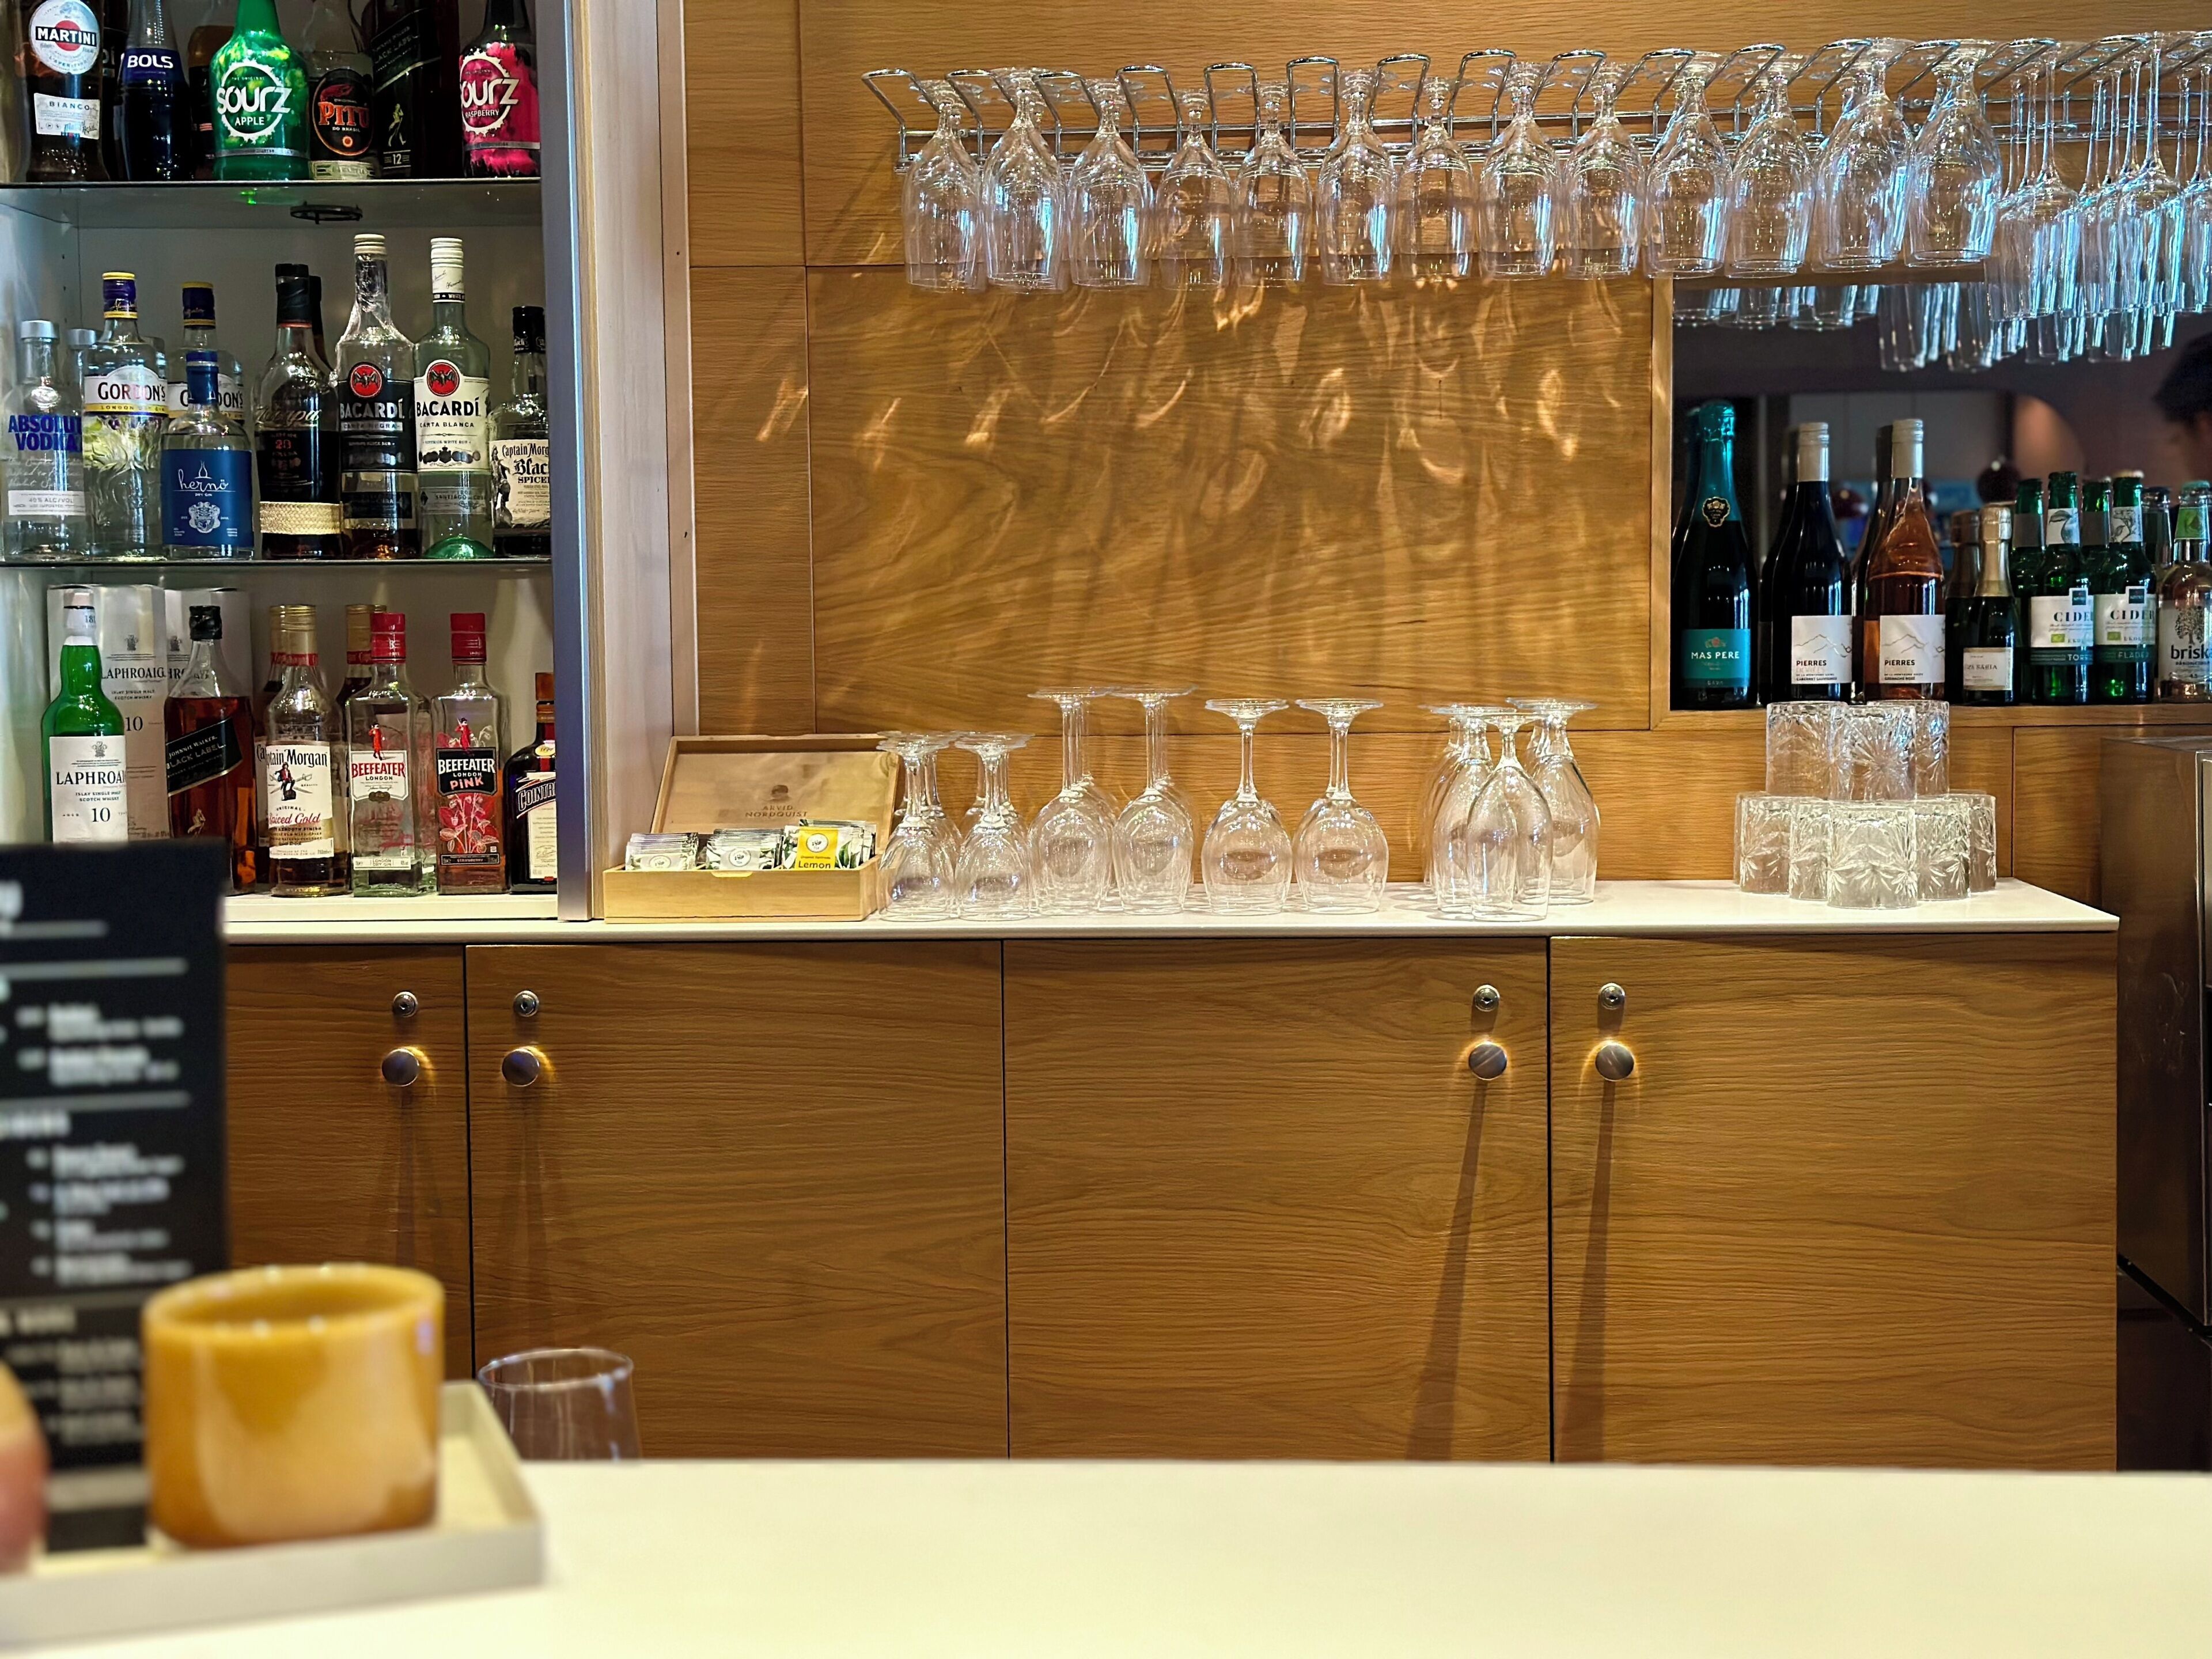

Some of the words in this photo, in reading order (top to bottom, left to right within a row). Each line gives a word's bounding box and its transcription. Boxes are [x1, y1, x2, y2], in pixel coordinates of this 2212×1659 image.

[37, 28, 95, 46] MARTINI
[127, 55, 173, 69] BOLS
[460, 78, 520, 108] ourz
[49, 101, 90, 111] BIANCO
[465, 109, 499, 118] RASPBERRY
[235, 116, 265, 126] APPLE
[393, 153, 402, 165] 12
[97, 381, 166, 402] GORDON'S
[339, 397, 403, 419] BACARDÍ
[416, 396, 480, 417] BACARDÍ
[15, 433, 78, 451] VODKA
[502, 443, 528, 459] Captain
[178, 468, 229, 493] hernö
[1691, 652, 1712, 660] MAS
[1715, 650, 1740, 659] PERE
[125, 716, 143, 732] 10
[195, 743, 225, 757] LABEL
[284, 749, 328, 768] Morgan
[437, 758, 496, 775] BEEFEATER
[56, 770, 126, 785] LAPHROAI
[351, 762, 406, 779] BEEFEATER
[518, 782, 556, 812] COINTR
[92, 806, 111, 823] 10
[294, 812, 321, 824] Gold
[798, 860, 831, 869] Lemon
